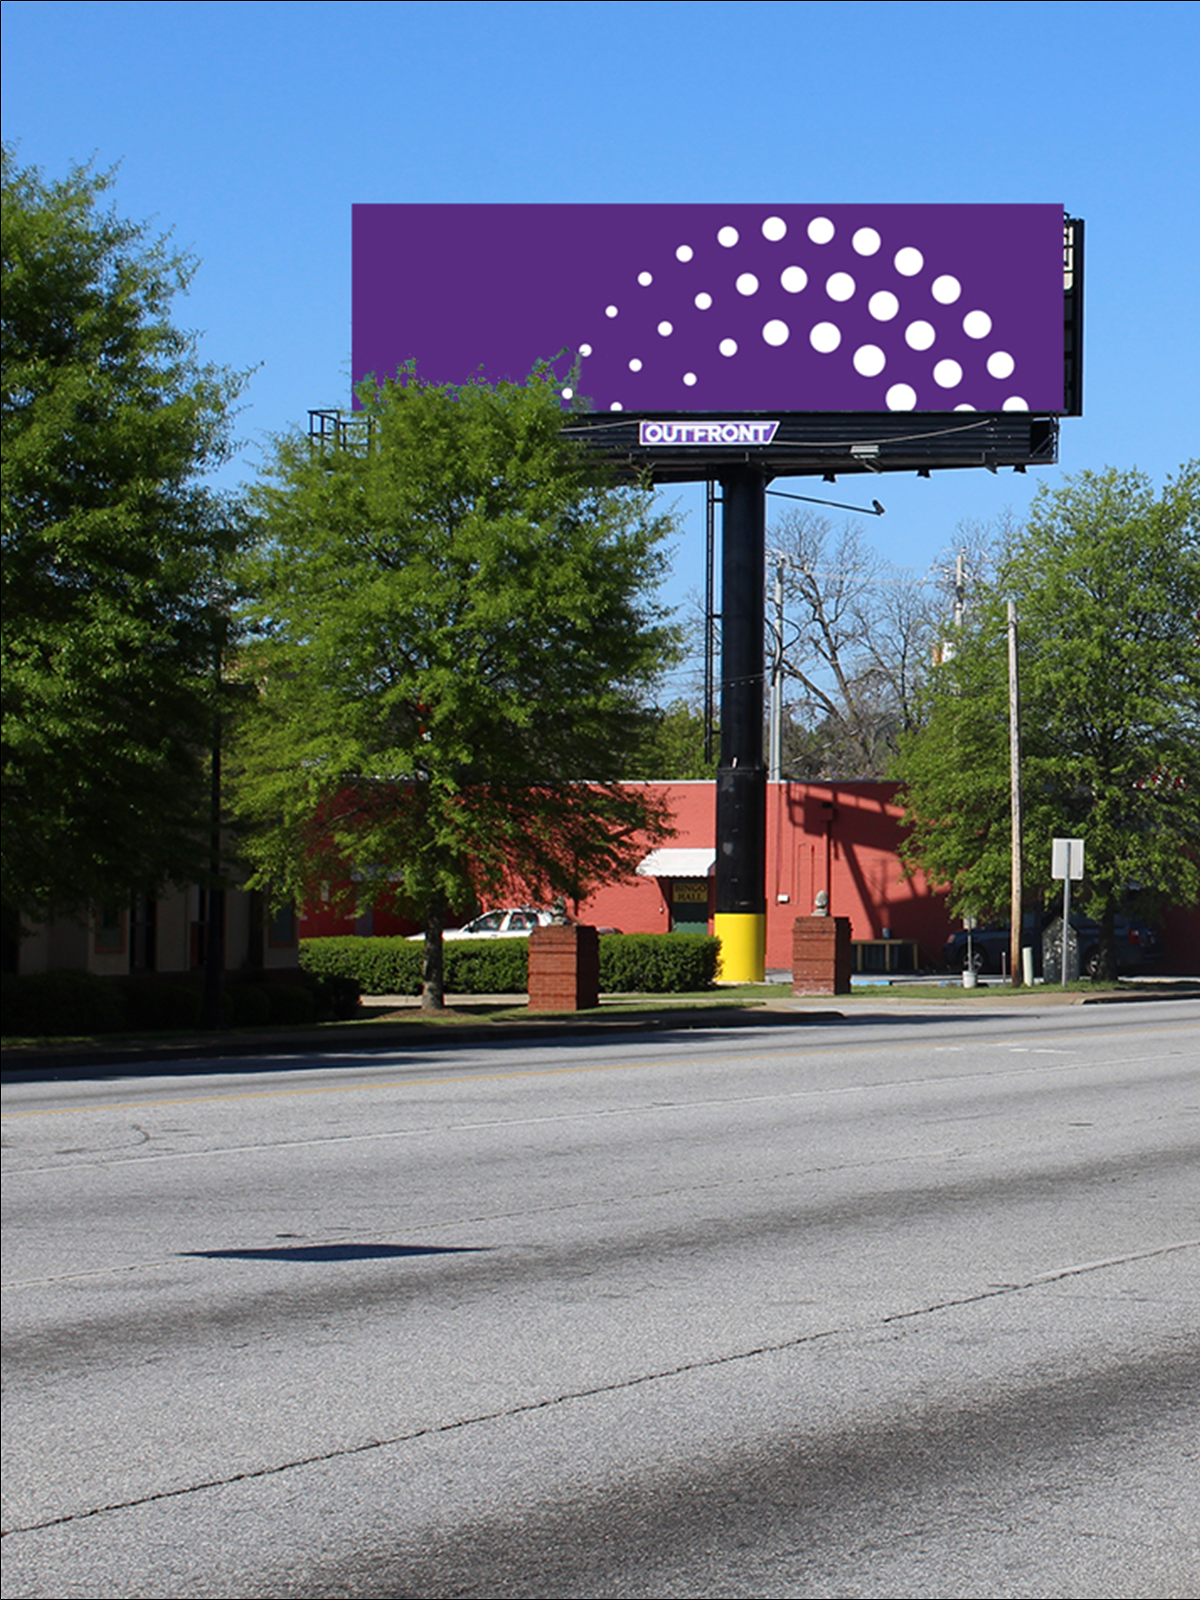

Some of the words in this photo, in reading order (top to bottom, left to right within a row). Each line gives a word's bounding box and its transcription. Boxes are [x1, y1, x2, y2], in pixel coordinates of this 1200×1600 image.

[645, 424, 771, 442] OUTFRONT
[673, 883, 708, 893] BINGO
[677, 893, 702, 901] HALL
